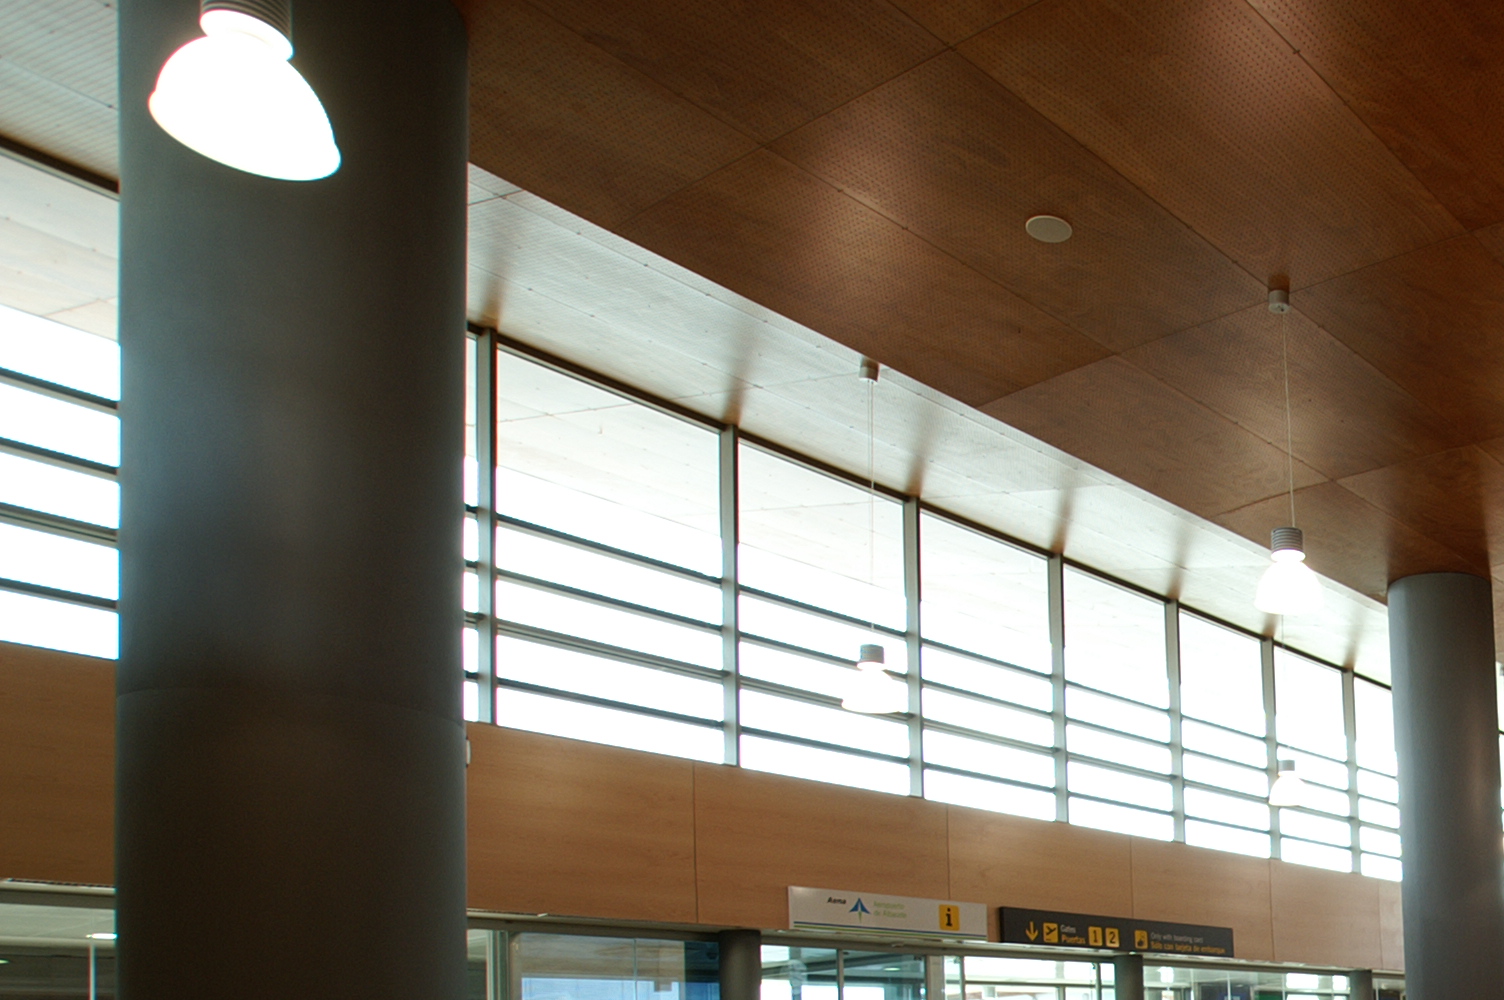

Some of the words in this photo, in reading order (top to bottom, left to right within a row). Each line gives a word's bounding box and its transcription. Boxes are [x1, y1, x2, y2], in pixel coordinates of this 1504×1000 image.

[1060, 924, 1076, 933] Gates
[1061, 934, 1086, 944] Puertas
[1093, 930, 1098, 943] 1
[1109, 931, 1116, 944] 2
